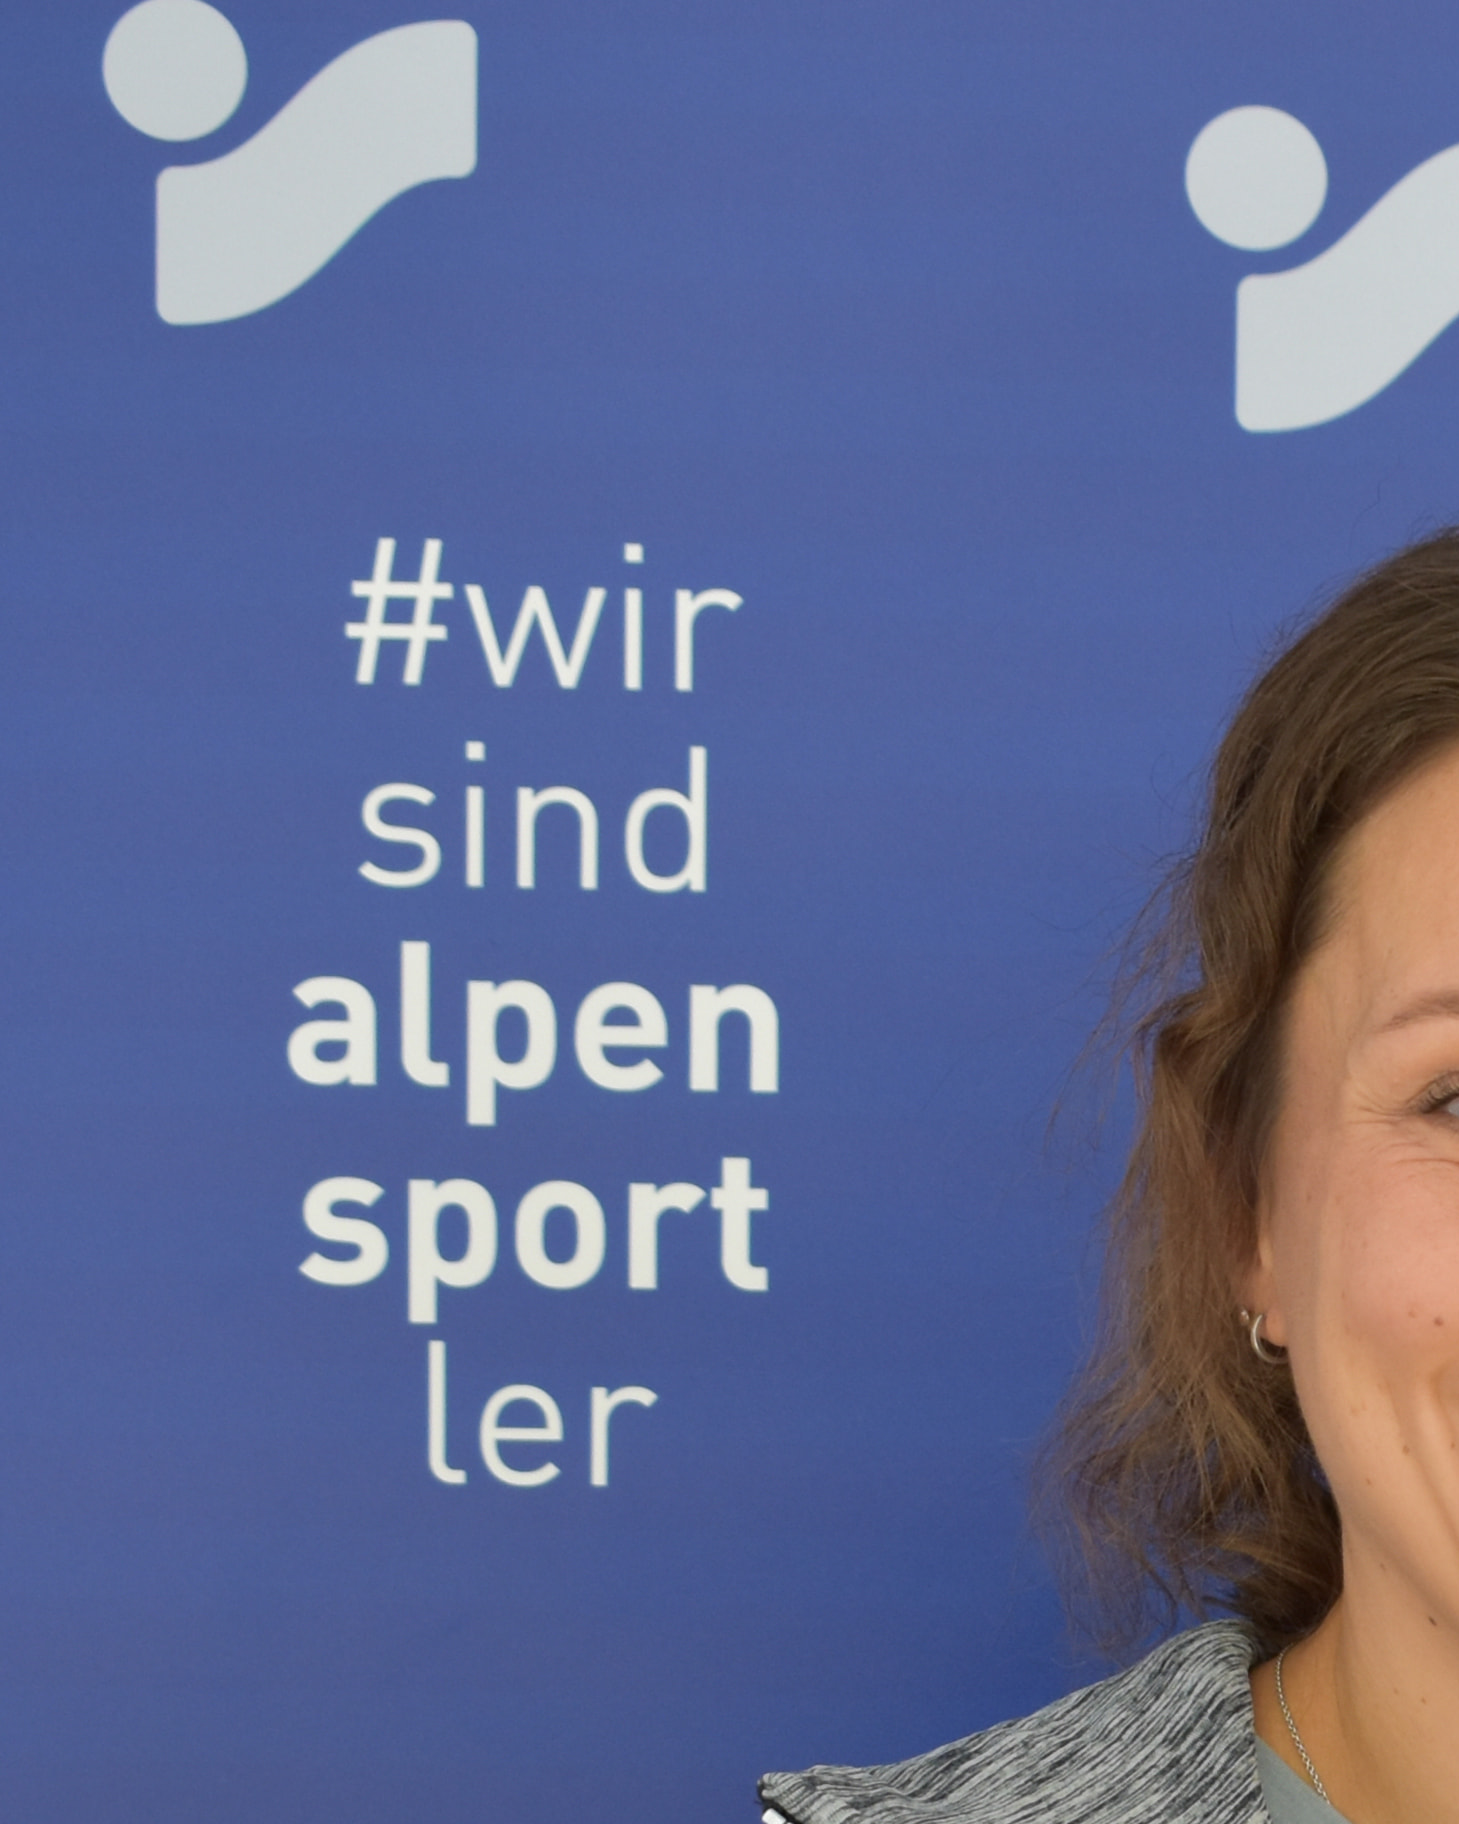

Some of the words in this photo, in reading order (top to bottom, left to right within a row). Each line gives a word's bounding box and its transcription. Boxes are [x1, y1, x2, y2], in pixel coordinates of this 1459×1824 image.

[346, 538, 742, 690] #wir
[360, 742, 706, 891] sind
[288, 942, 777, 1125] alpen
[300, 1158, 767, 1323] sport
[429, 1341, 656, 1485] ler
